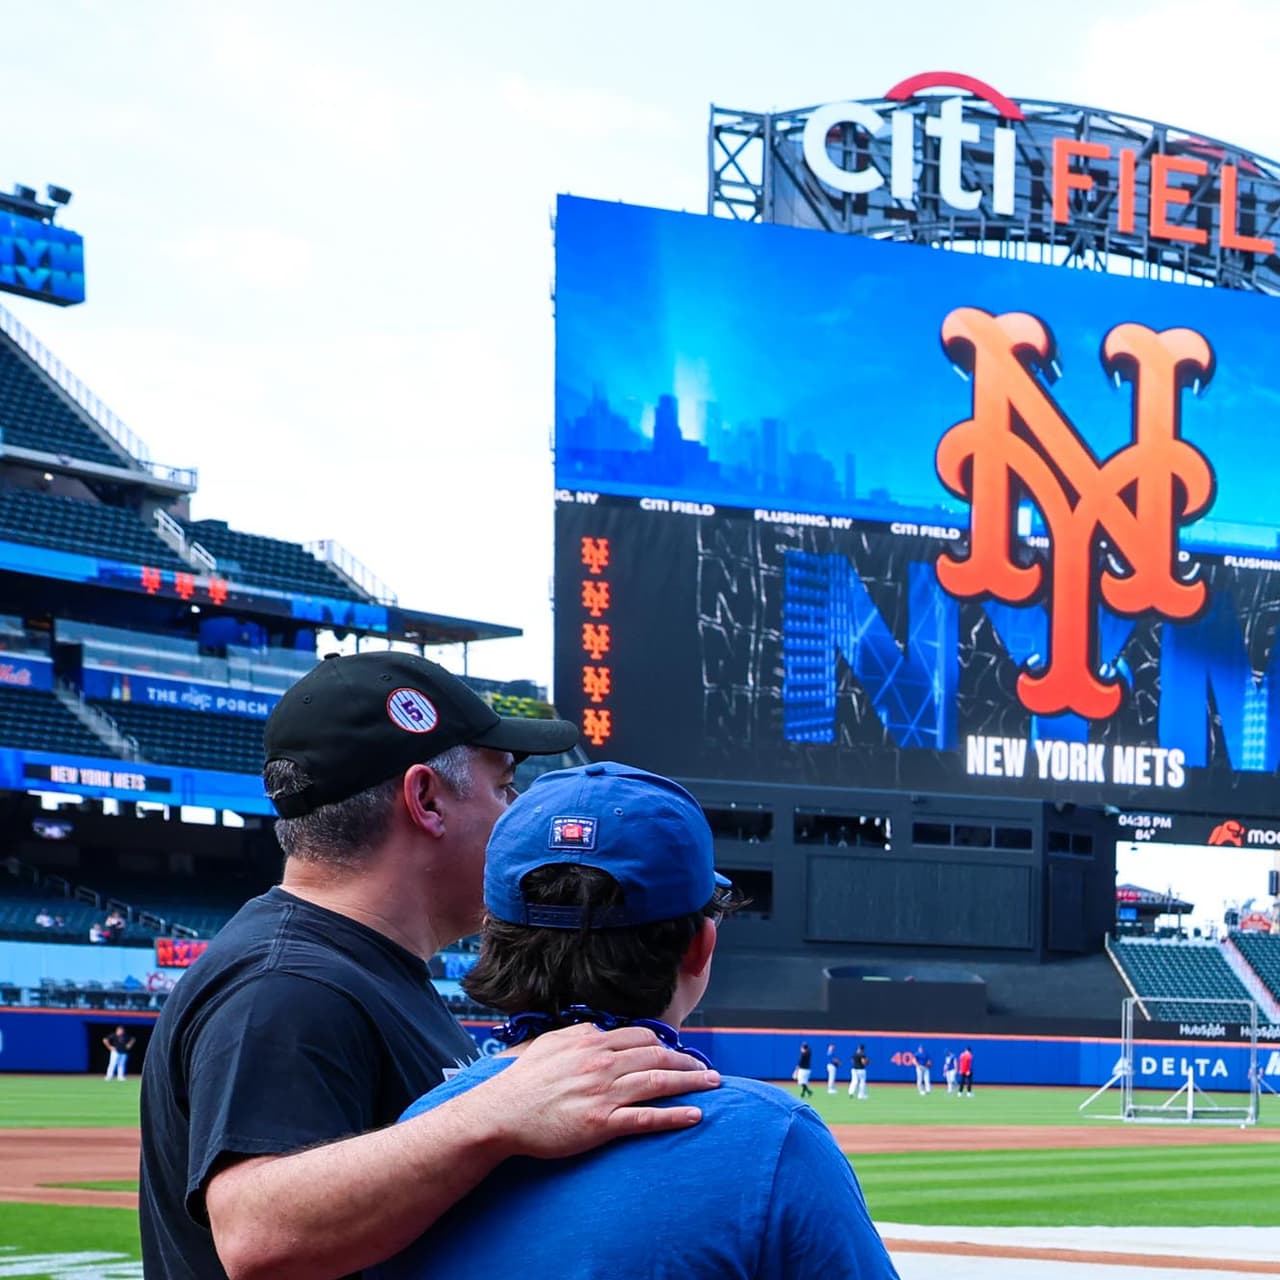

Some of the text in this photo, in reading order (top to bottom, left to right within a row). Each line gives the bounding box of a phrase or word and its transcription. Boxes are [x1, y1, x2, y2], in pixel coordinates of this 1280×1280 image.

[640, 498, 715, 516] CITI FIELD
[831, 517, 853, 530] NY
[891, 522, 960, 540] CITI FIELD
[147, 687, 178, 704] THE
[217, 696, 269, 715] PORCH
[401, 700, 423, 722] 5
[966, 735, 1185, 788] NEW YORK METS
[50, 765, 146, 791] NEW YORK METS
[1118, 815, 1172, 829] 04:35 PM
[1180, 1023, 1225, 1038] HubSpot
[1141, 1056, 1228, 1077] DELTA
